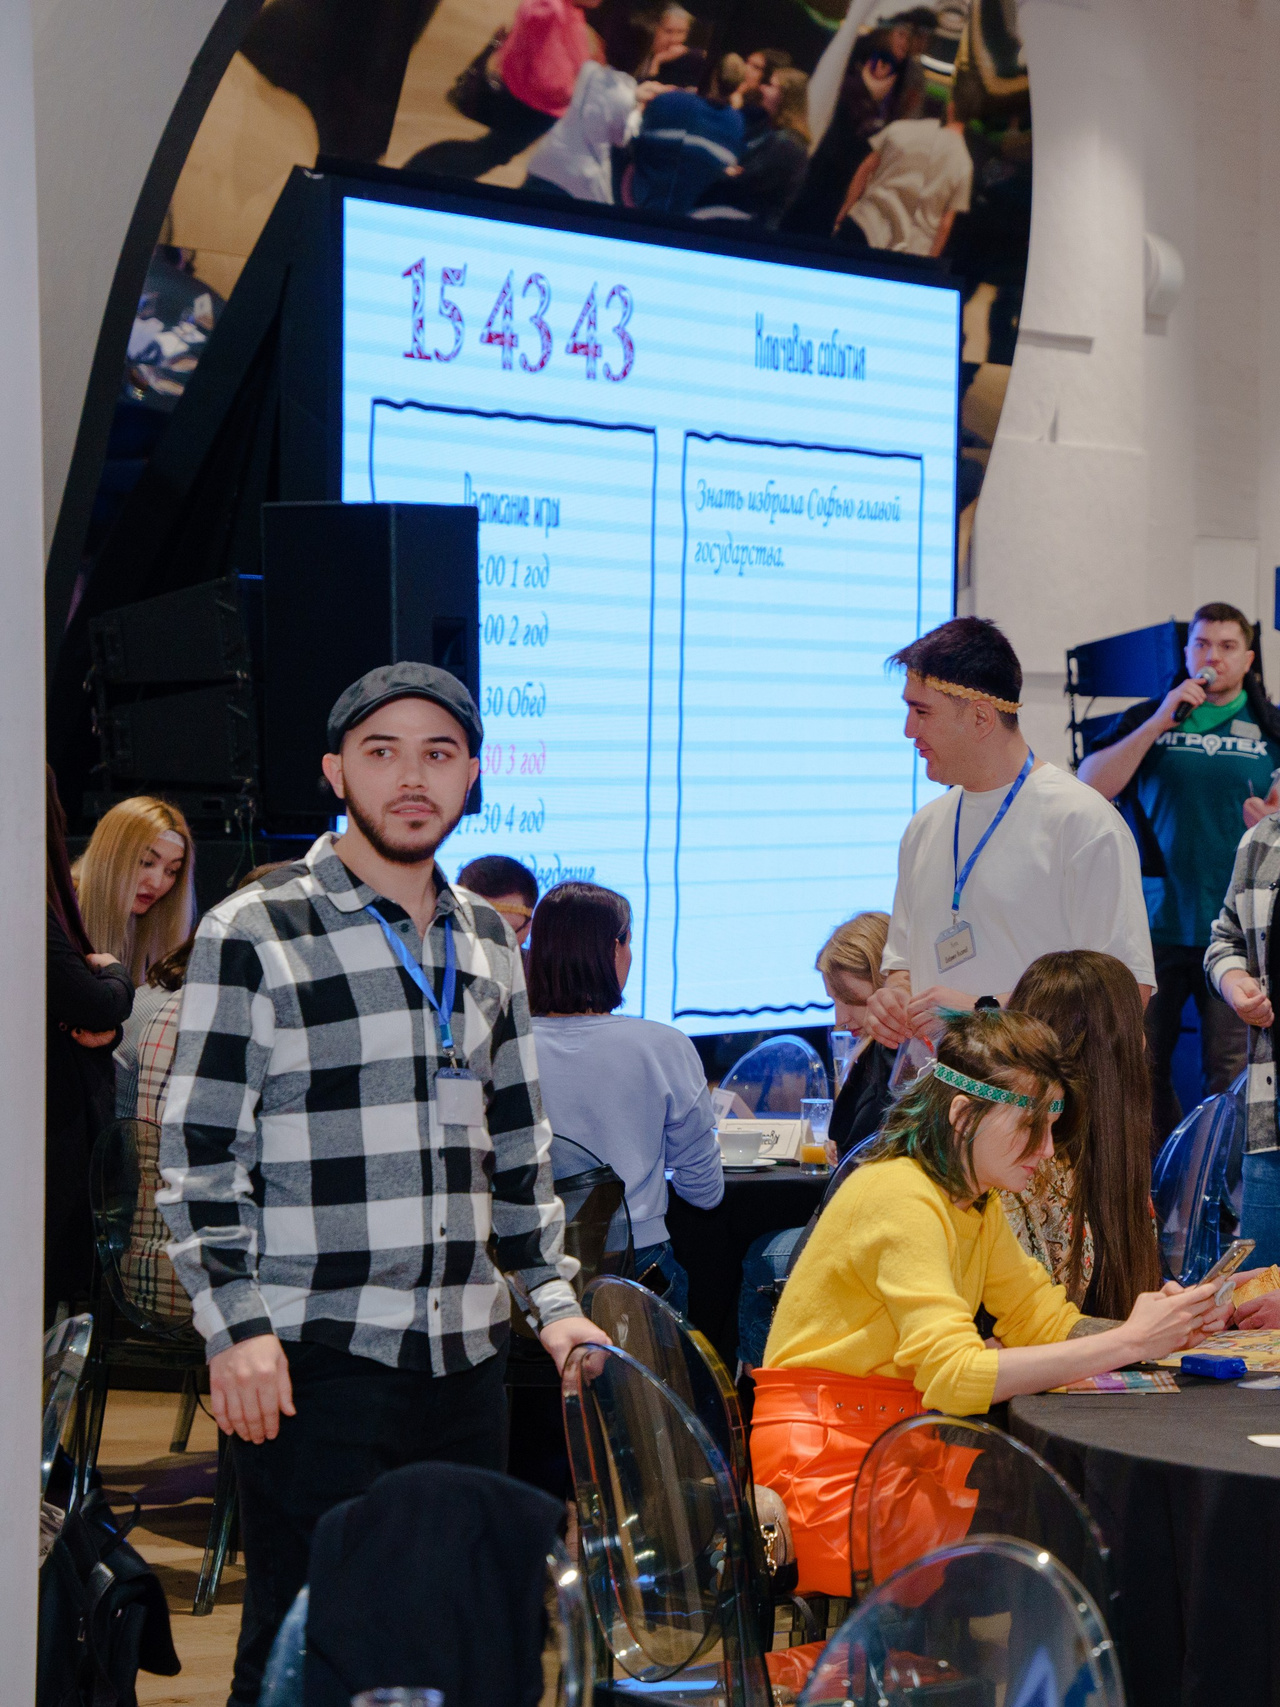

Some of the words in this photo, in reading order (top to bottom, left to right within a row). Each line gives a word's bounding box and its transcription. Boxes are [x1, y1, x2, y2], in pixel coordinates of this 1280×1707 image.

[402, 257, 467, 363] 15
[480, 269, 553, 374] 43
[565, 281, 635, 382] 43
[817, 328, 865, 381] события
[533, 497, 560, 538] игры
[695, 478, 744, 512] Знать
[747, 479, 804, 525] избрала
[807, 485, 855, 527] Софью
[856, 496, 900, 522] главой
[511, 556, 519, 588] 1
[523, 551, 550, 588] год
[694, 530, 785, 577] государства.
[508, 614, 519, 647] 2
[522, 608, 549, 648] год
[507, 681, 546, 718] Обед
[506, 744, 516, 775] 3
[520, 738, 547, 775] год
[504, 803, 515, 833] 4
[519, 796, 546, 834] год
